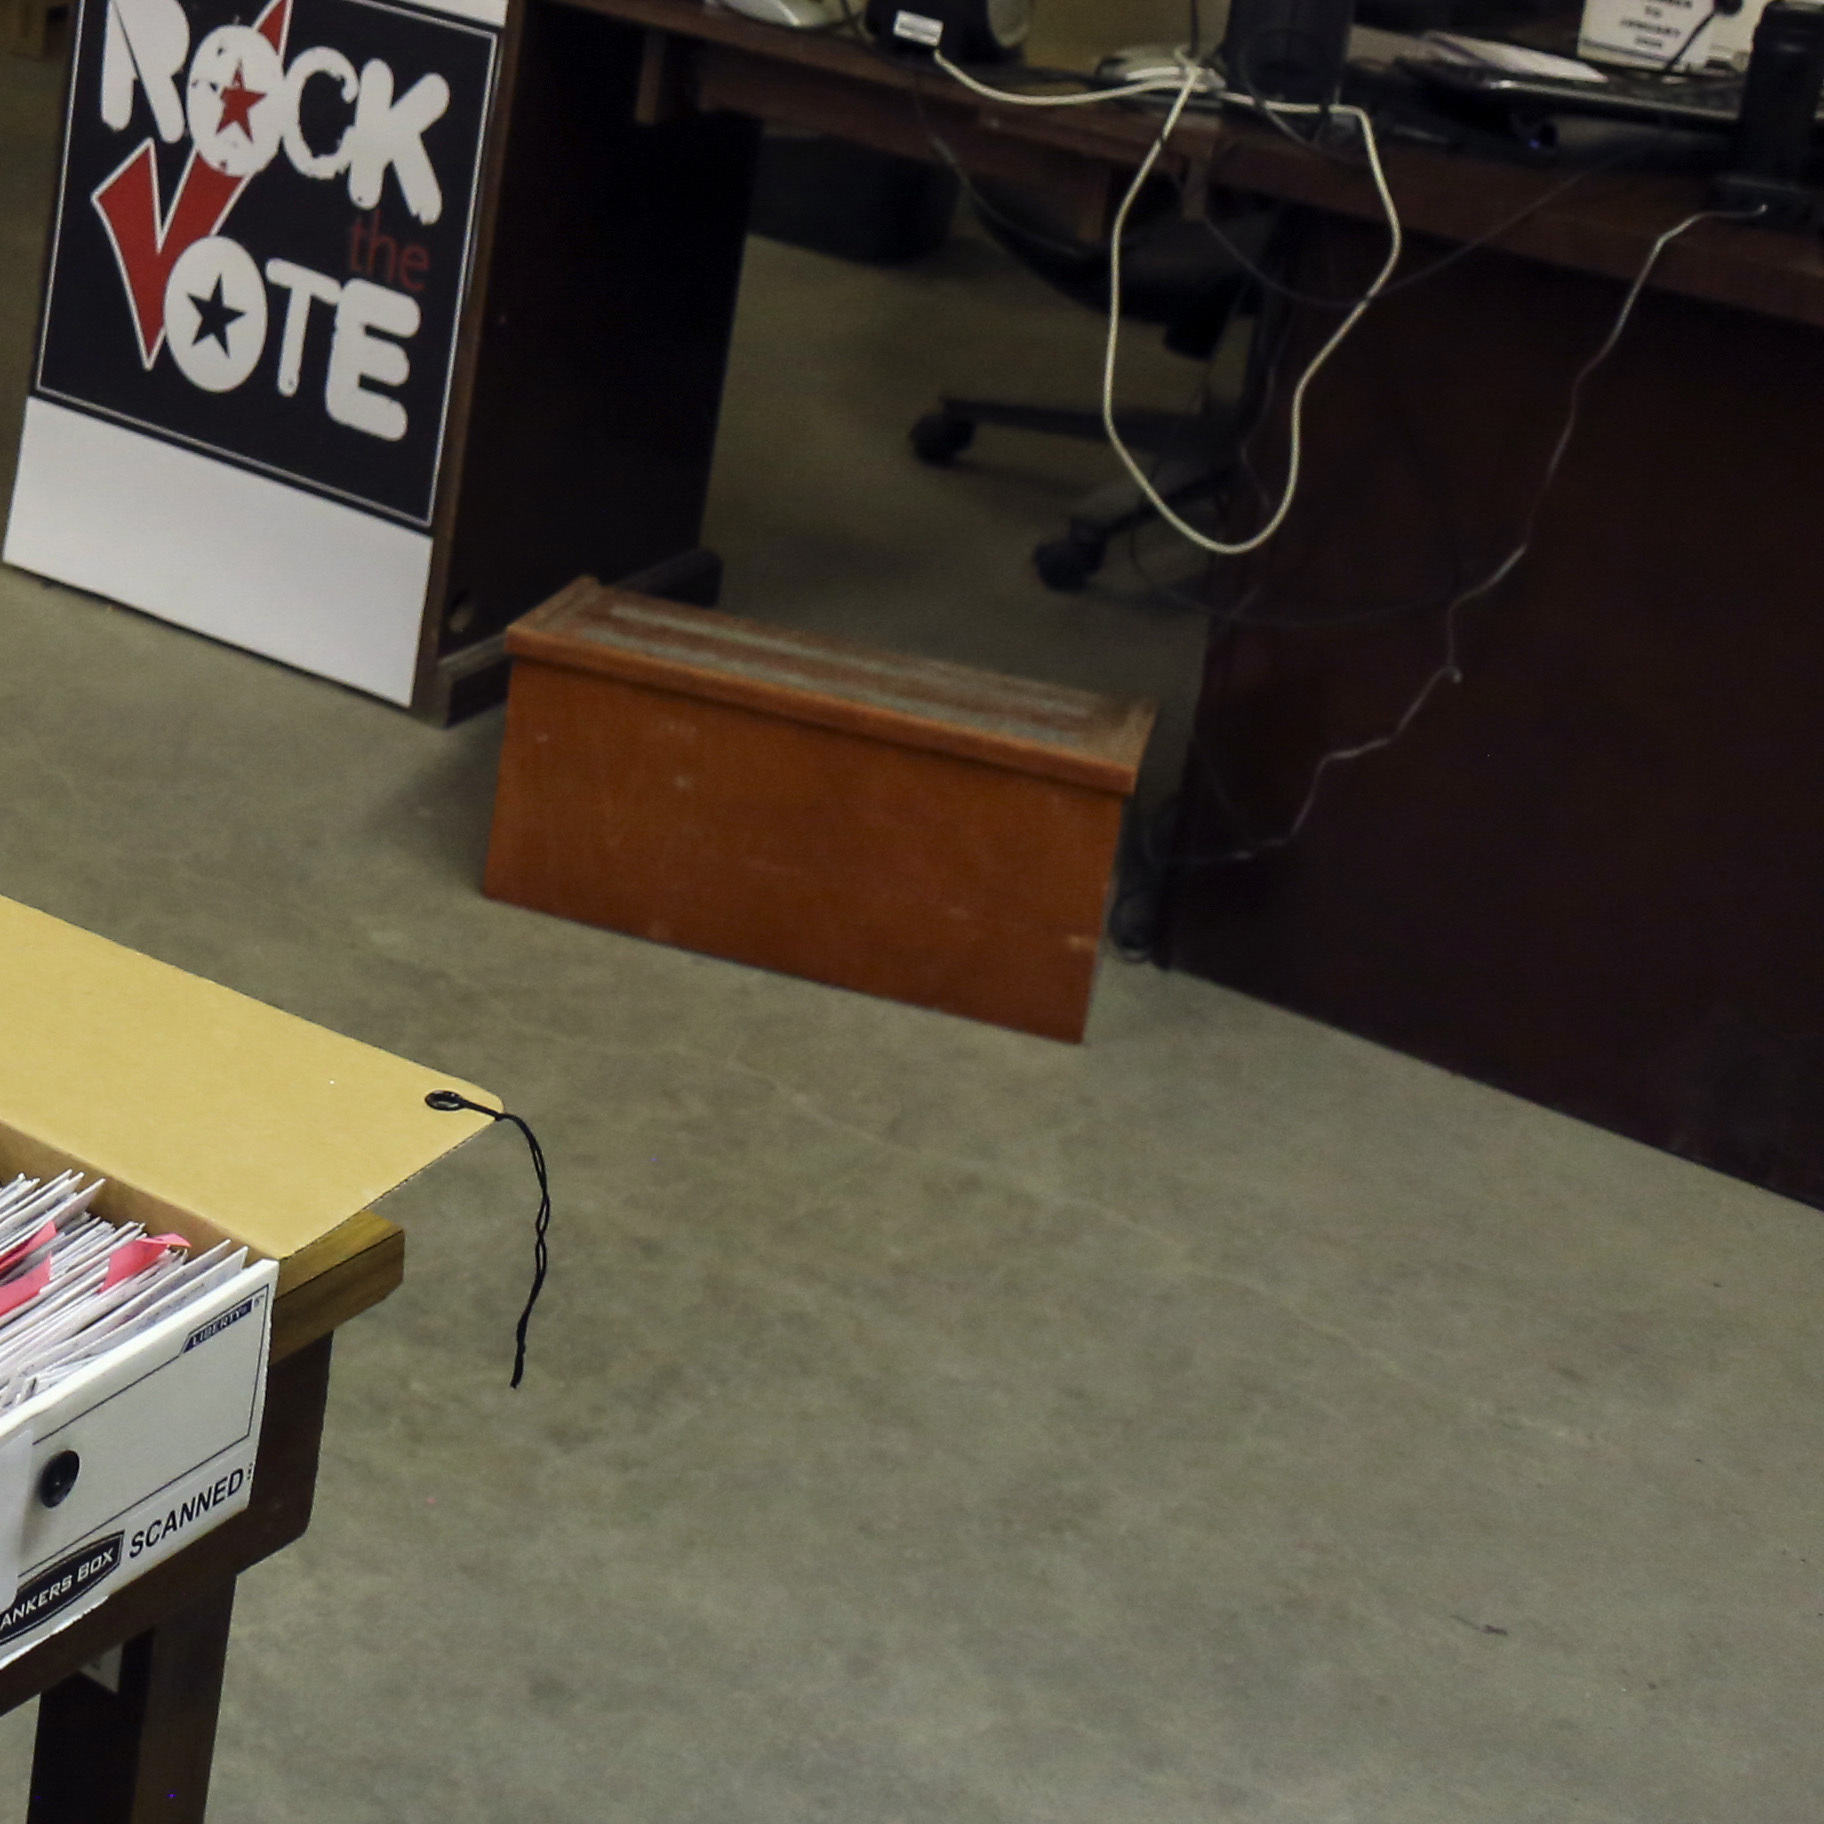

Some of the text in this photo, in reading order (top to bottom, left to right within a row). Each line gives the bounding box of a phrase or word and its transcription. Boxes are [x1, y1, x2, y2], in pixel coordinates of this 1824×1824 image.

[91, 136, 422, 442] VOTE
[349, 215, 429, 292] the
[129, 1467, 244, 1558] SCANNED
[77, 1548, 115, 1583] BOX
